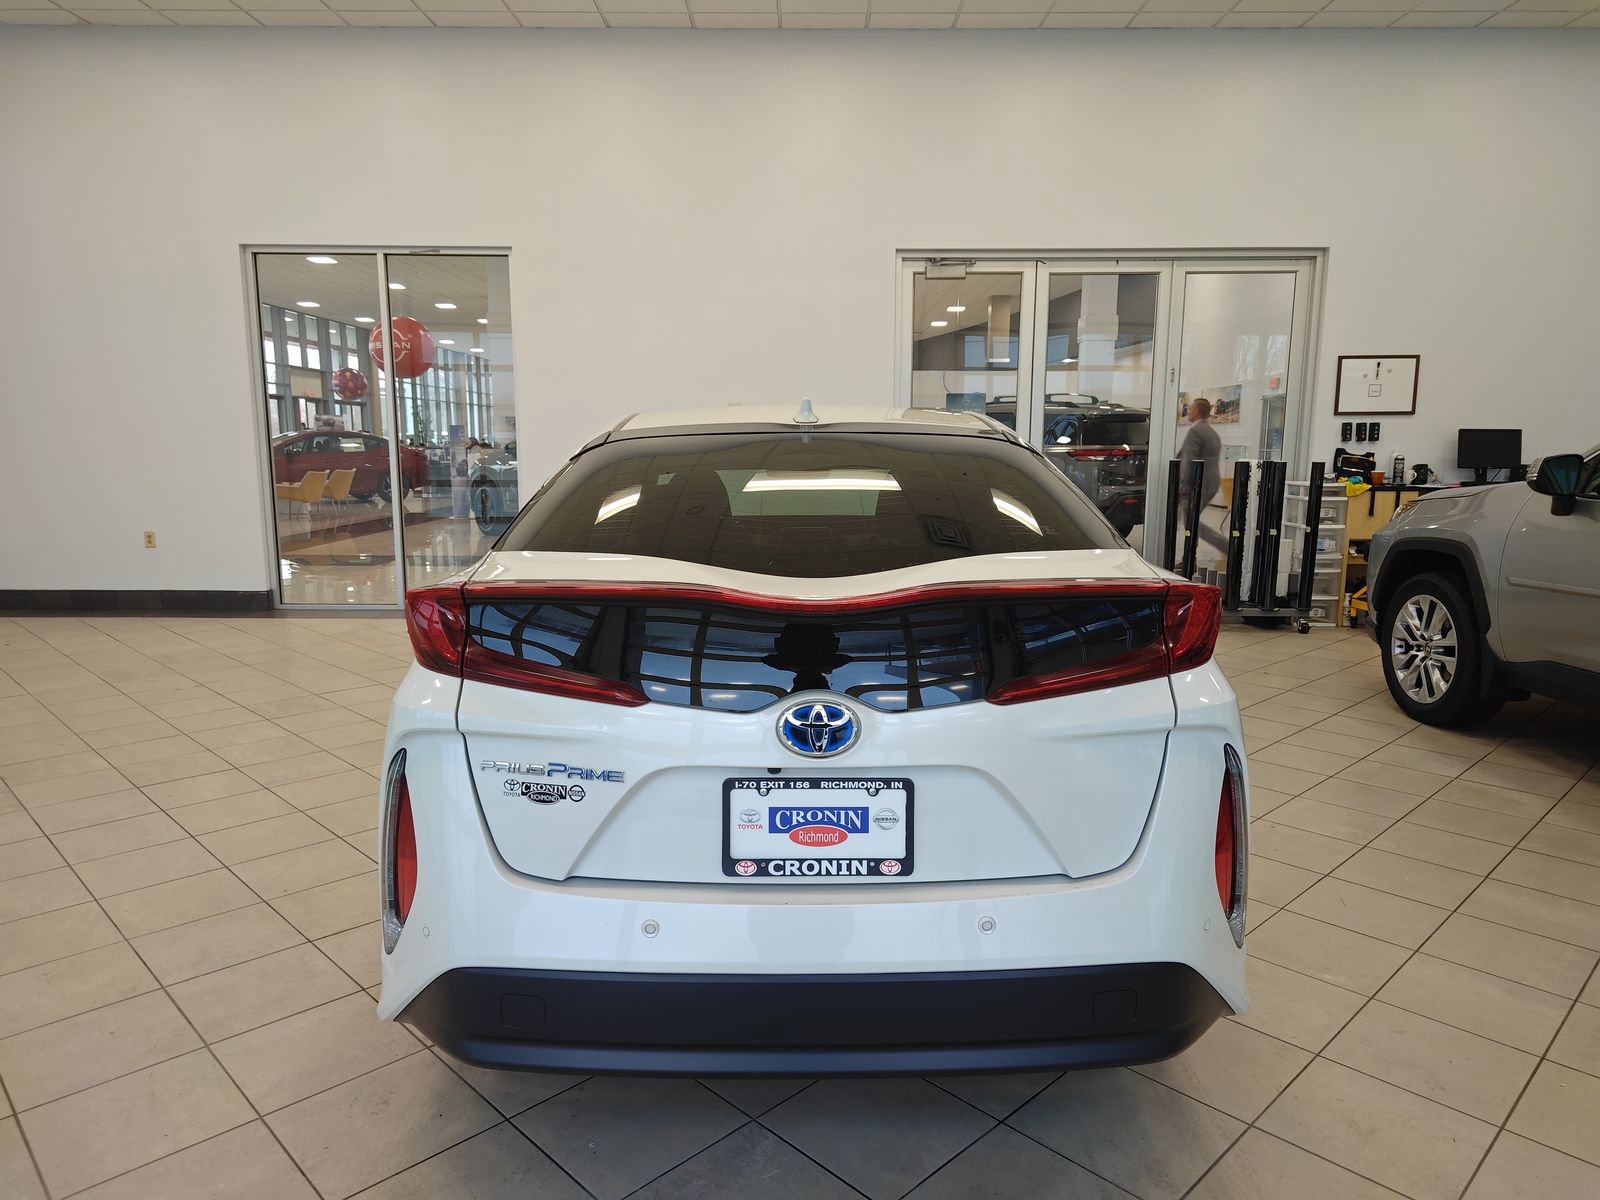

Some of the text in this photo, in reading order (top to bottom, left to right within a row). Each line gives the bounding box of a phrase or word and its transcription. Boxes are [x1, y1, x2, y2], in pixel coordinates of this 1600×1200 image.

[481, 760, 625, 783] PRIUS PRIME
[522, 783, 567, 797] CRONIN
[820, 781, 888, 789] RICHMOND,
[530, 793, 558, 802] RICHMOND
[775, 810, 862, 830] CRONIN
[798, 830, 839, 843] Richmond
[768, 860, 867, 875] CRONIN
